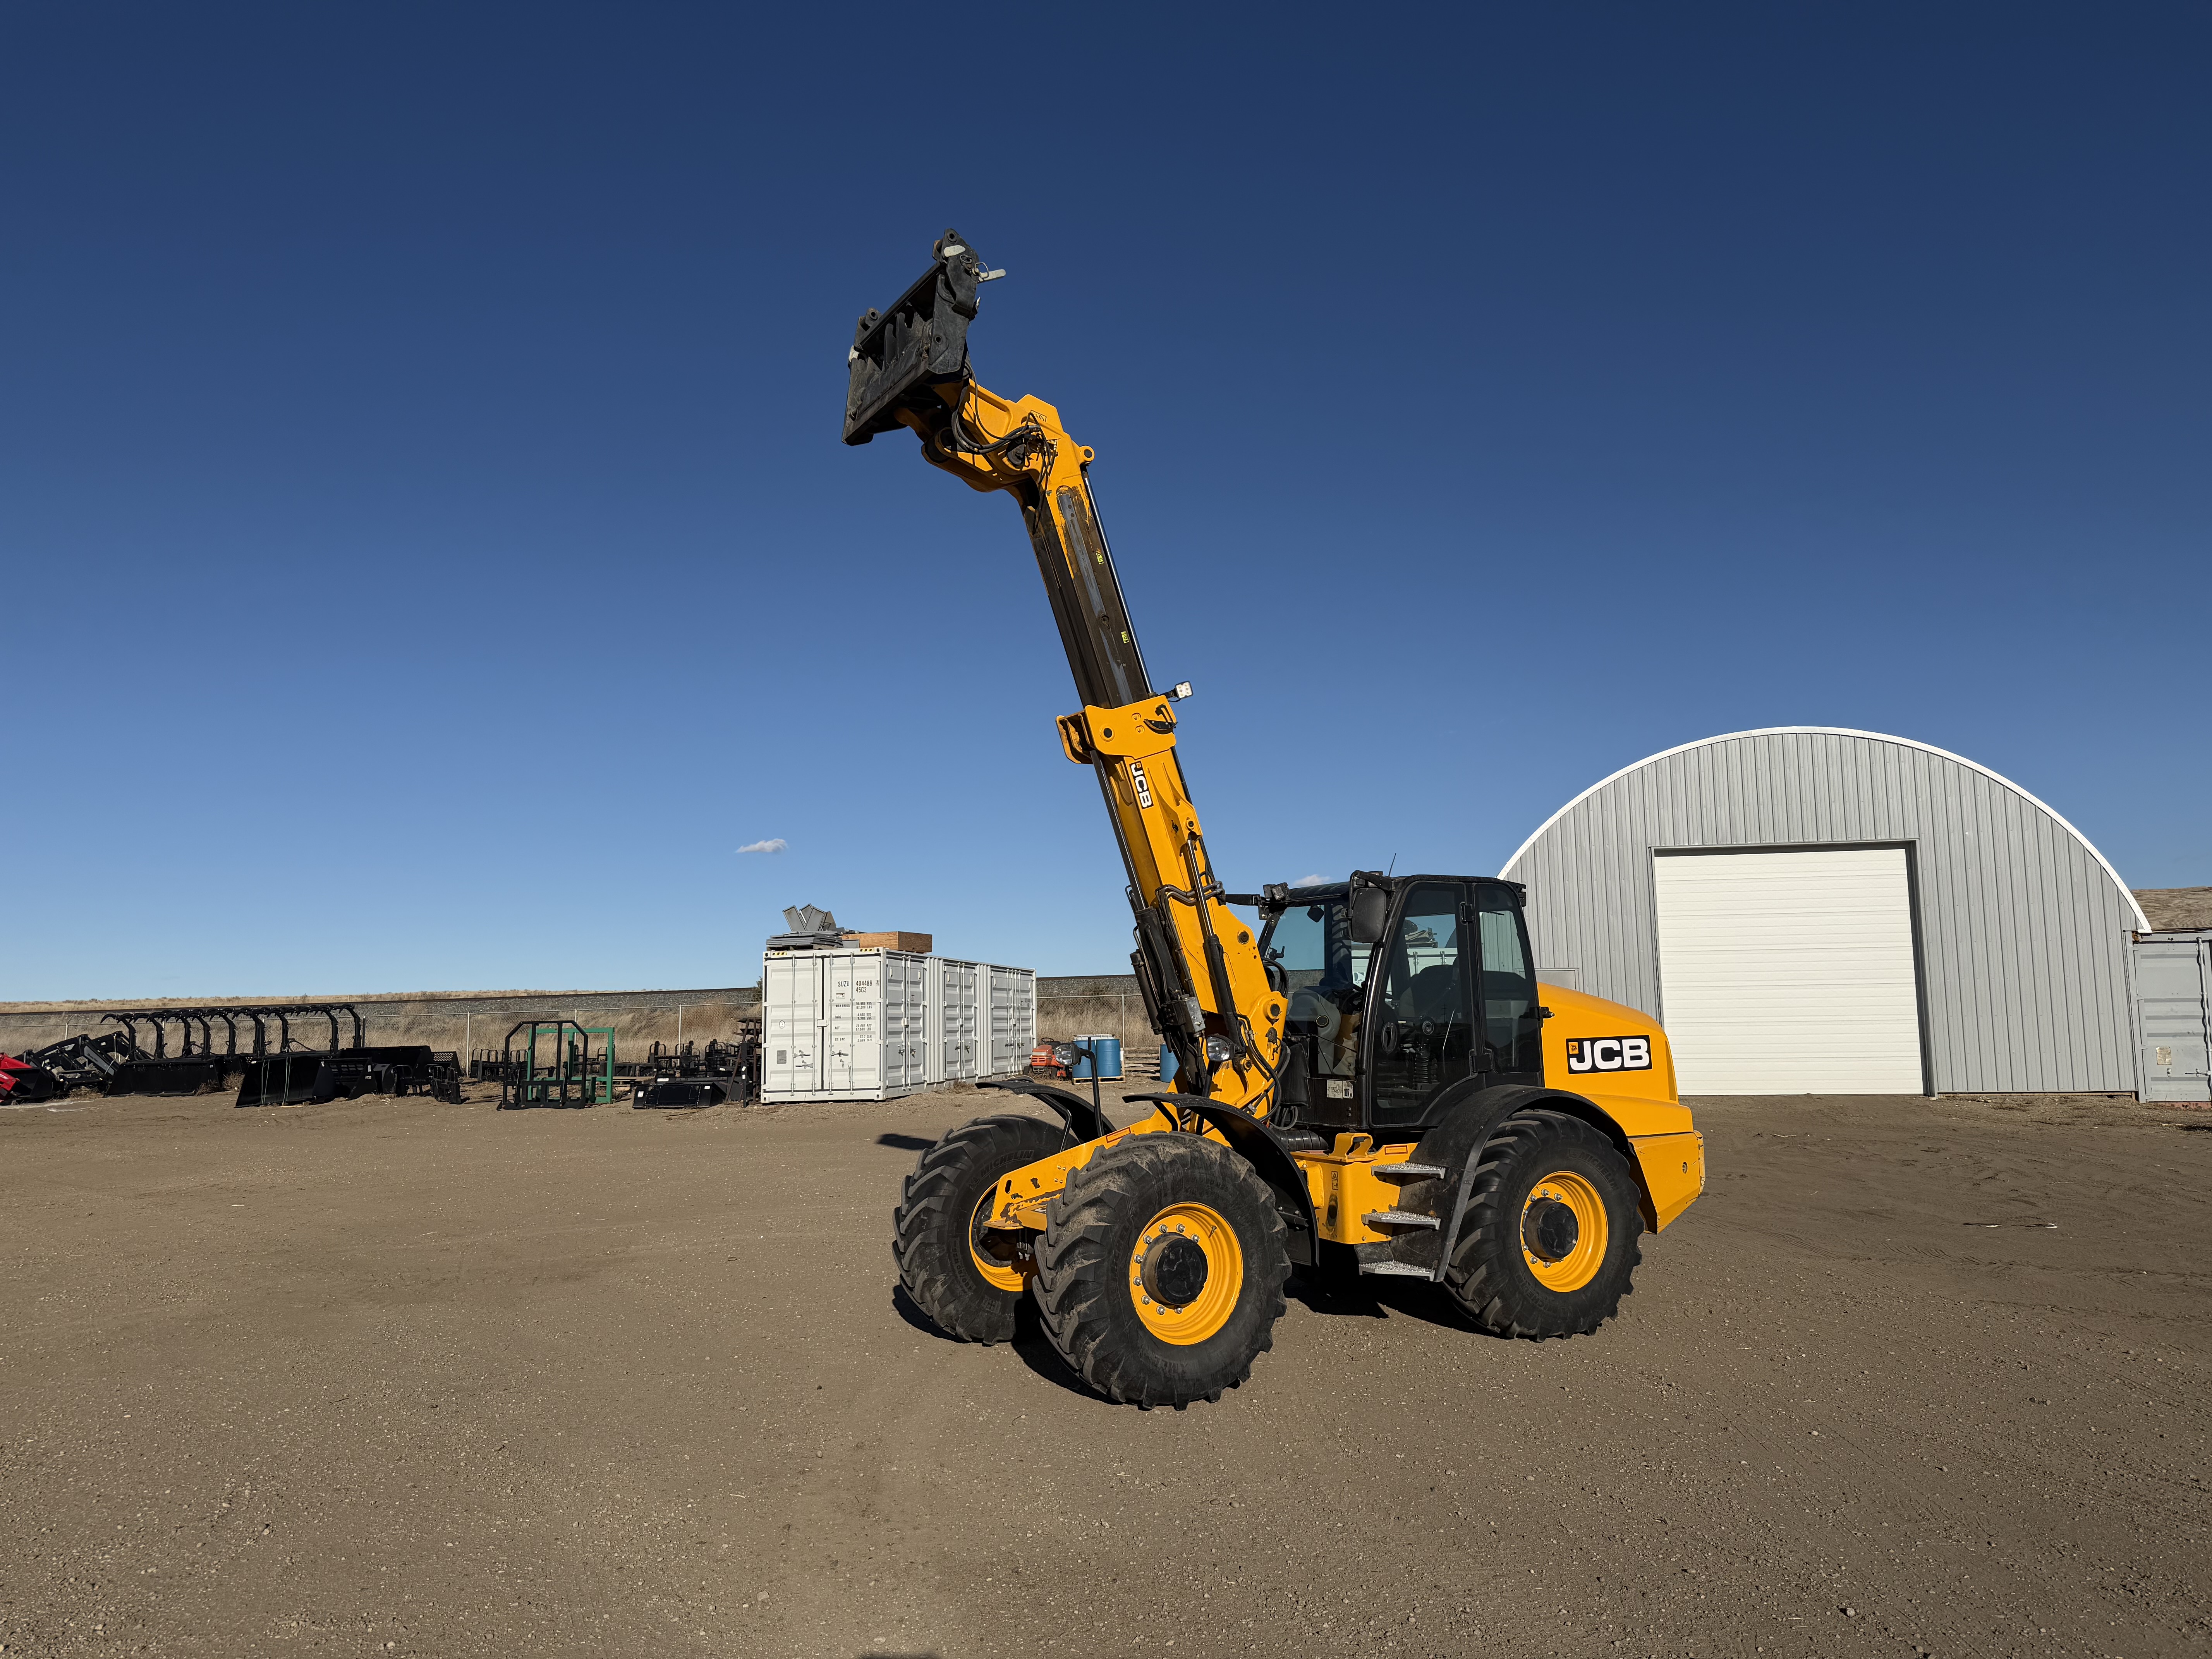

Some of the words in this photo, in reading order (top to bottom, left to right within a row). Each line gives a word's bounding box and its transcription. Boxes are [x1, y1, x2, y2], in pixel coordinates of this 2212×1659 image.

[1131, 763, 1152, 808] JCB
[1570, 1038, 1650, 1071] JCB
[980, 1150, 1034, 1178] MICHELIN
[1578, 1151, 1619, 1191] MICHELIN
